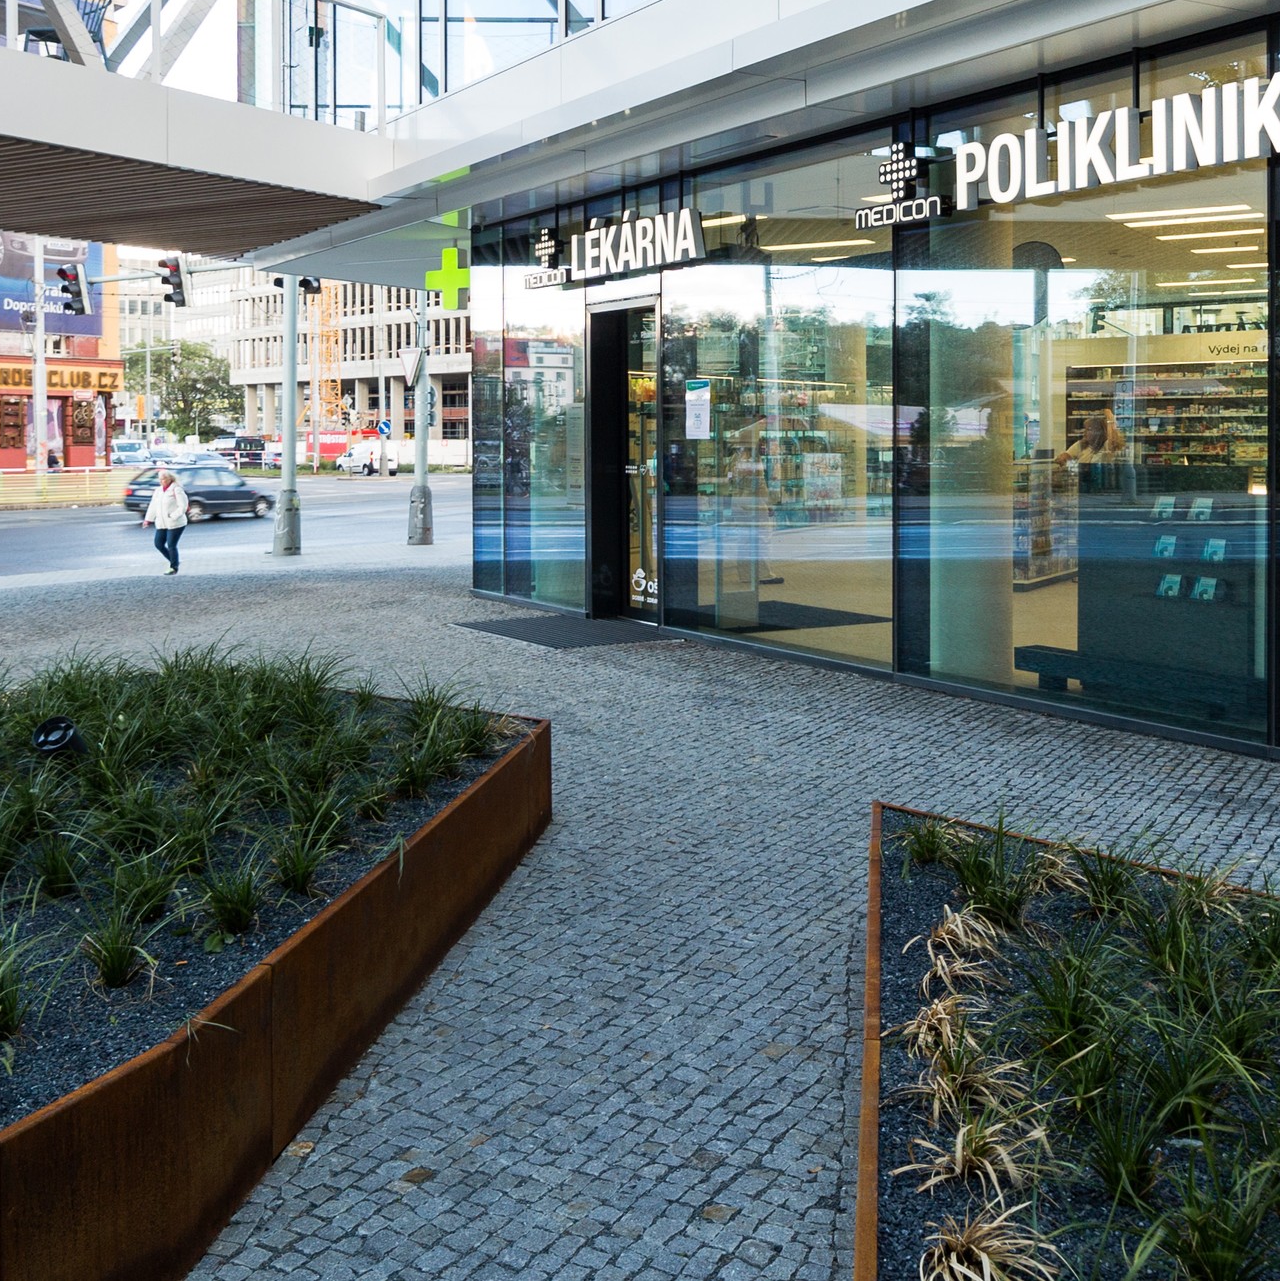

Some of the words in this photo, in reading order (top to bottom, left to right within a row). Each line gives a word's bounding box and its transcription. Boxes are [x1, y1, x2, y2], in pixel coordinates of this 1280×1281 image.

[856, 195, 941, 230] MEDICON
[571, 208, 703, 280] LÉKÁRNA
[1208, 344, 1240, 356] Výdej
[1243, 345, 1258, 353] na
